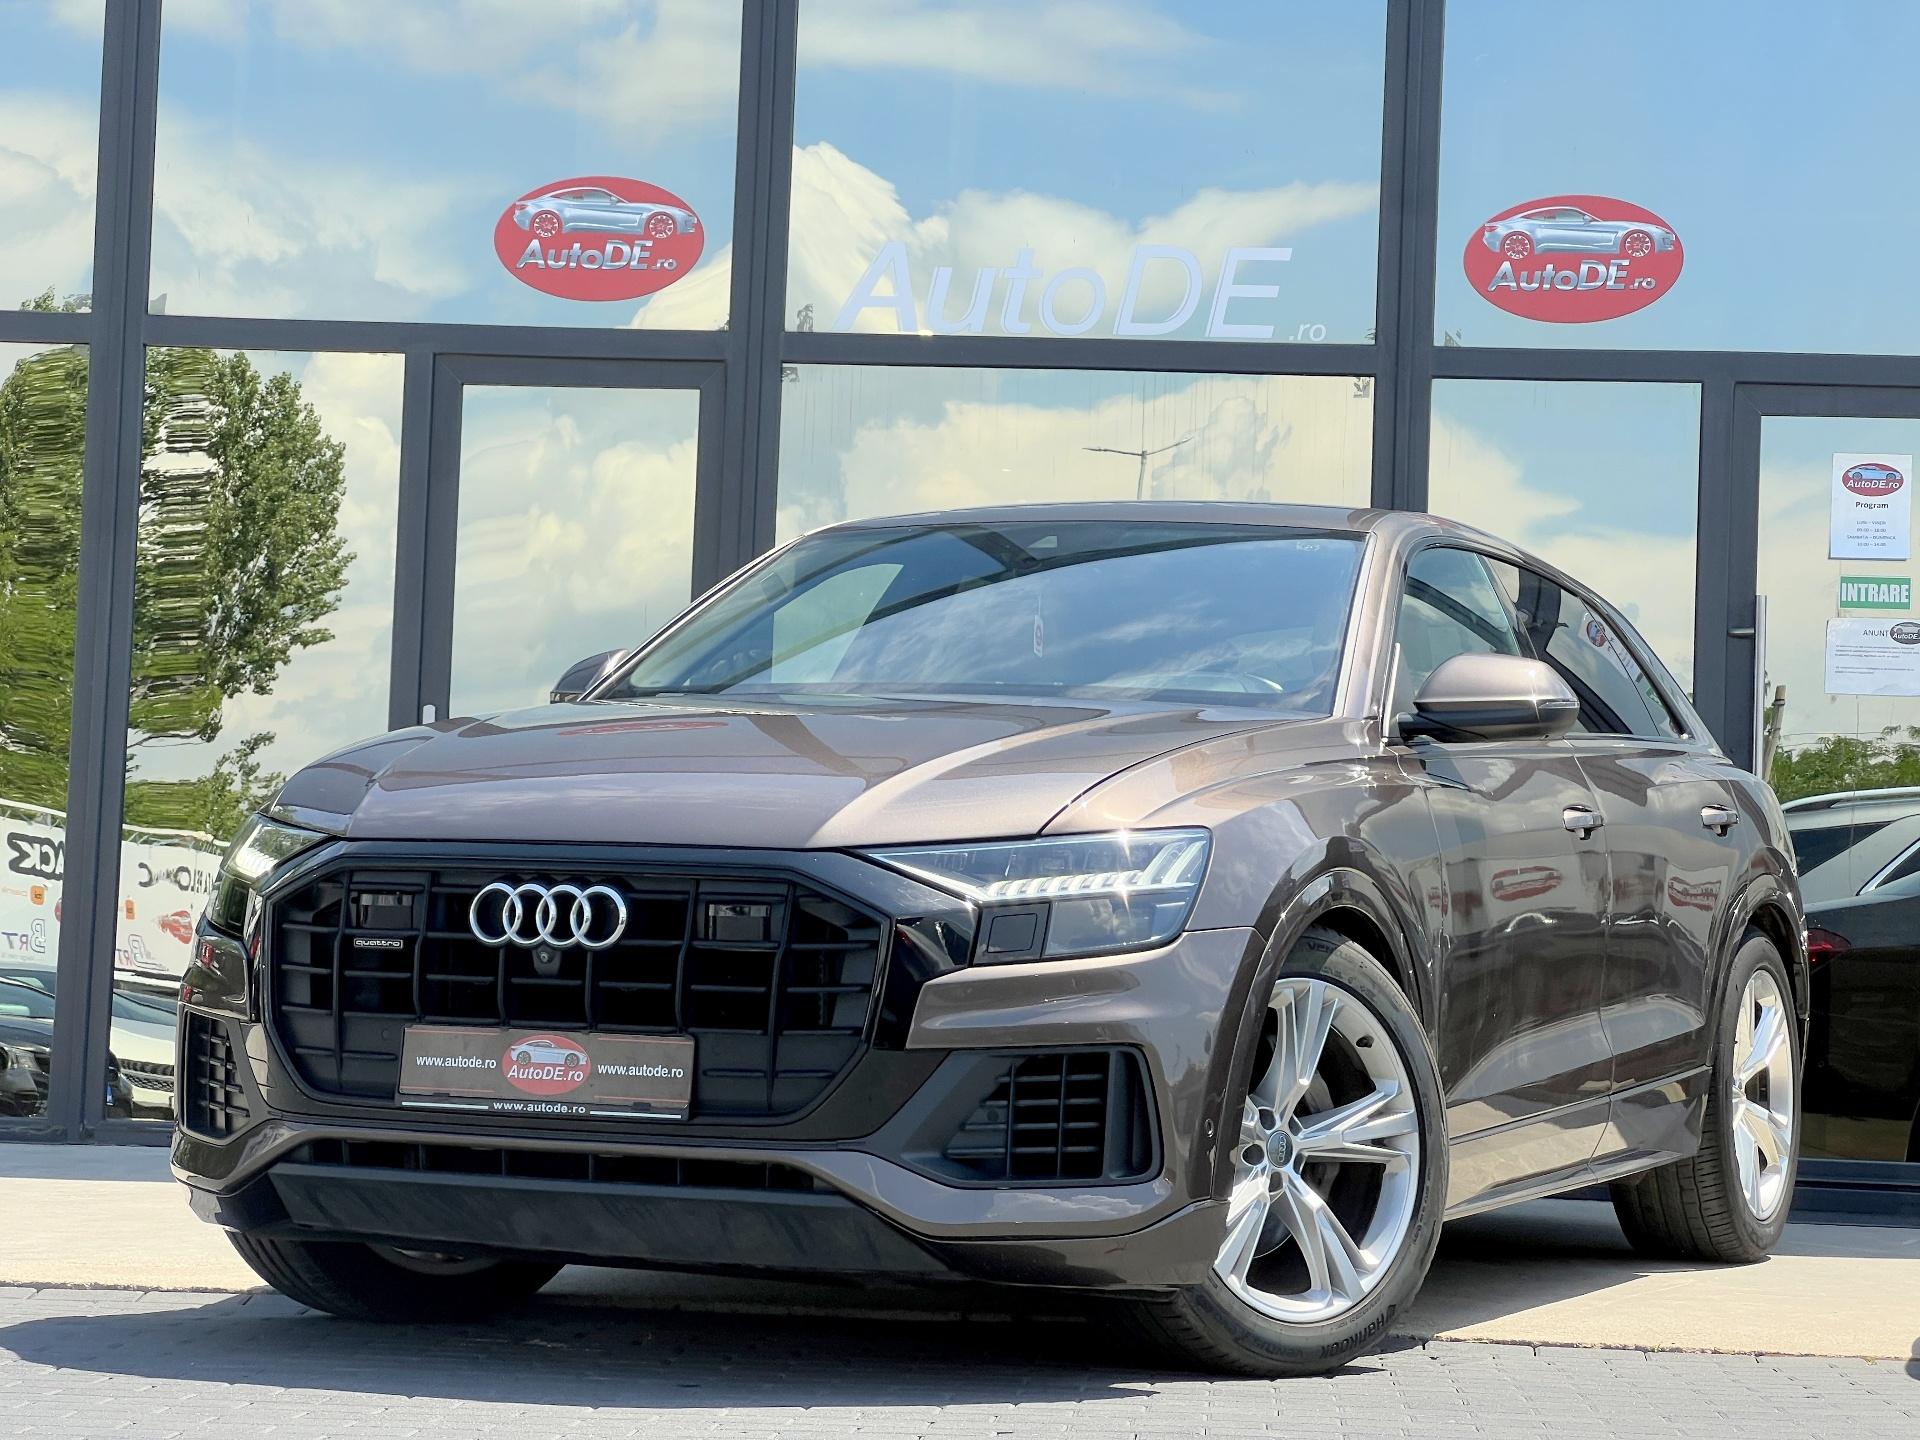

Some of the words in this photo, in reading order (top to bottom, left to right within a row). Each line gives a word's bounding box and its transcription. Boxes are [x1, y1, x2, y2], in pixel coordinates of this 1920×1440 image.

[1846, 479, 1900, 489] AutoDE.ro
[1855, 501, 1889, 510] Program
[1841, 582, 1910, 603] INTRARE
[354, 938, 402, 949] quattro
[416, 1054, 497, 1070] www.autode.ro
[507, 1064, 584, 1083] AutoDE.ro
[597, 1063, 684, 1079] www.autode.ro
[493, 1101, 586, 1115] www.autode.ro
